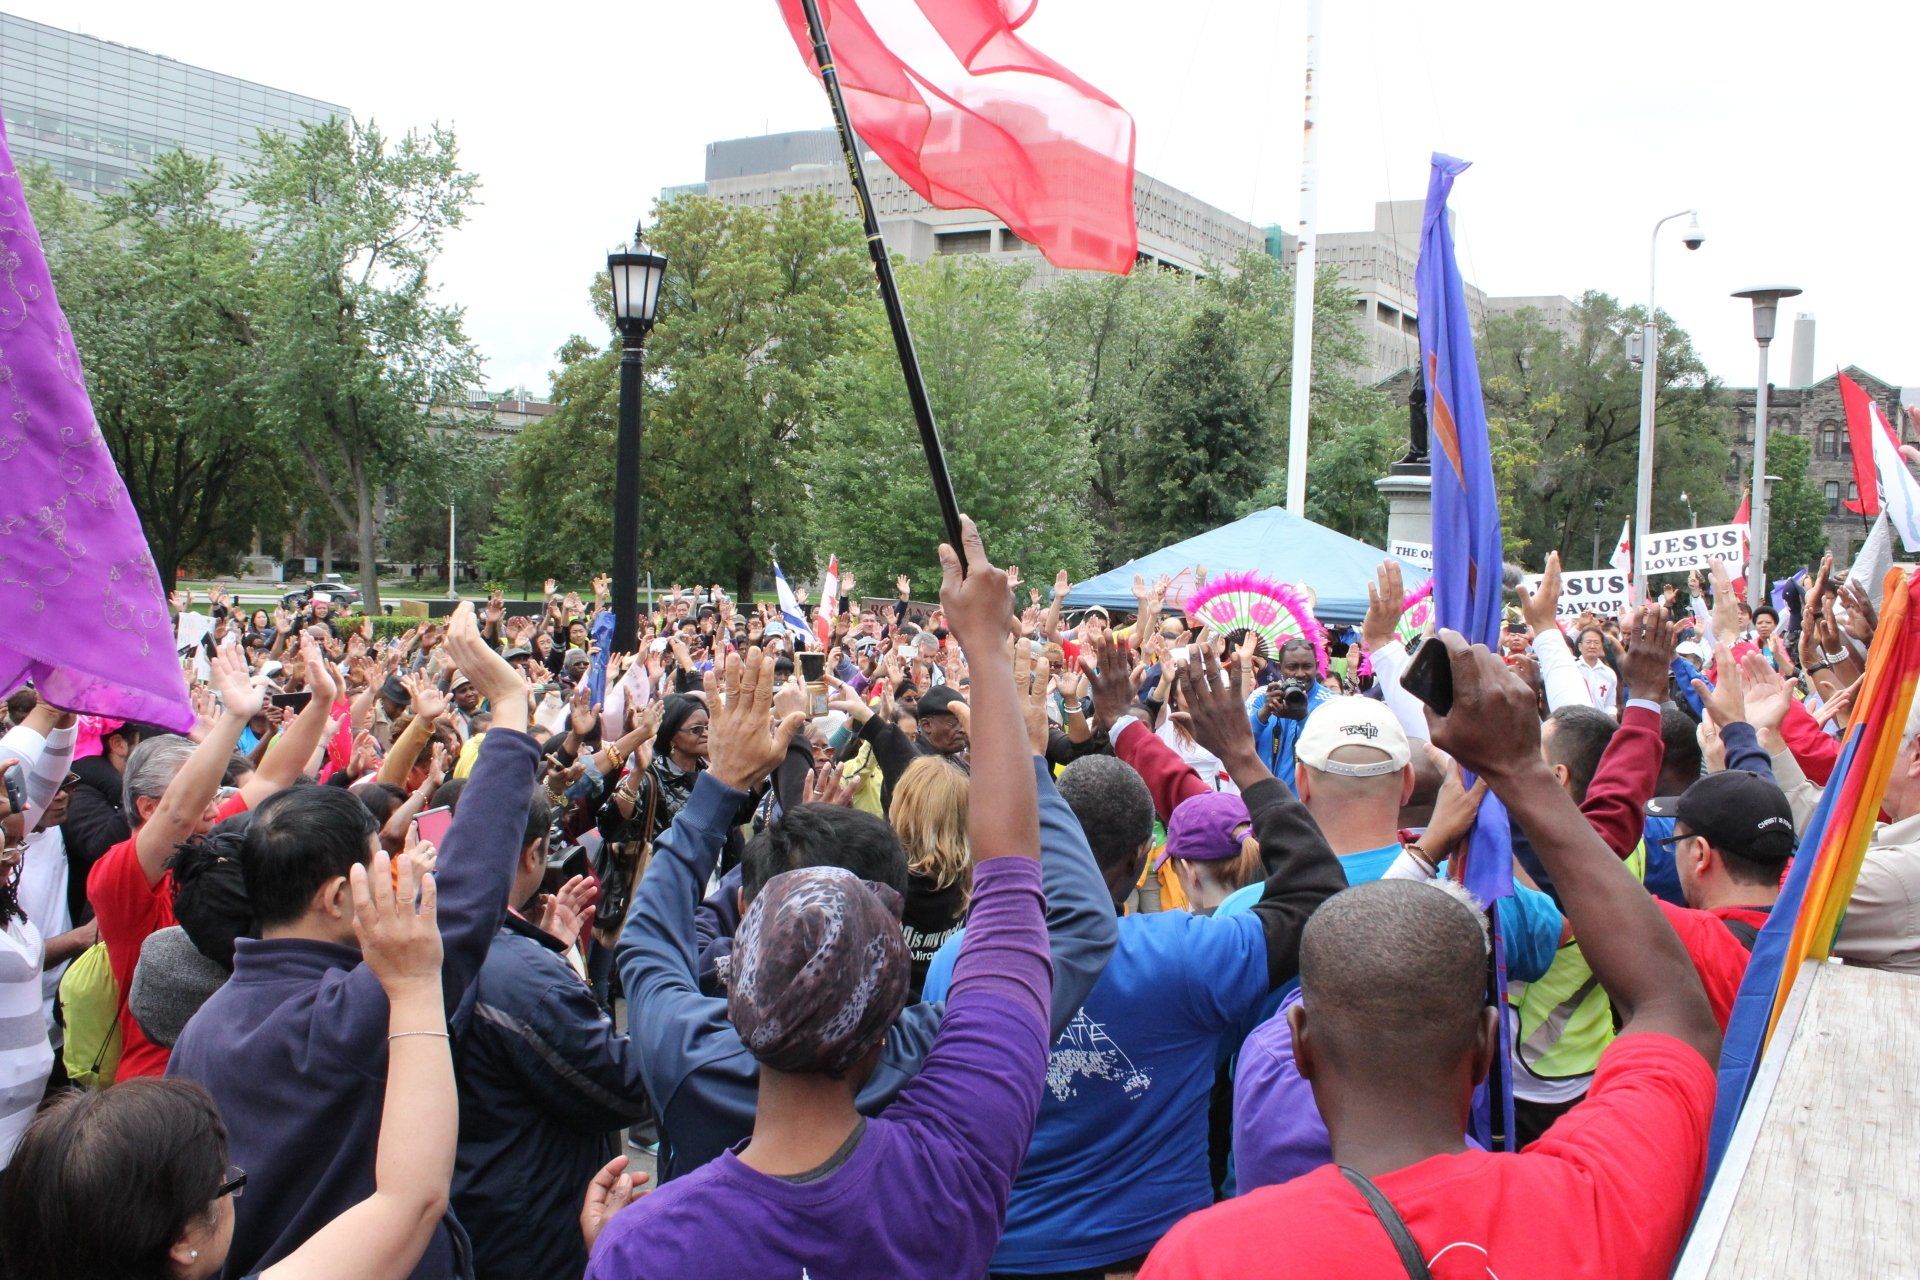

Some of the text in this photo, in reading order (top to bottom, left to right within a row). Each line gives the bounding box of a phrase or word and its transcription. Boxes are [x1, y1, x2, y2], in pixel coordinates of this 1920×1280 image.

[1648, 531, 1737, 555] JESUS
[1396, 546, 1418, 557] THE
[1645, 556, 1698, 570] LOVES
[1530, 576, 1624, 597] SUS
[911, 932, 923, 947] is
